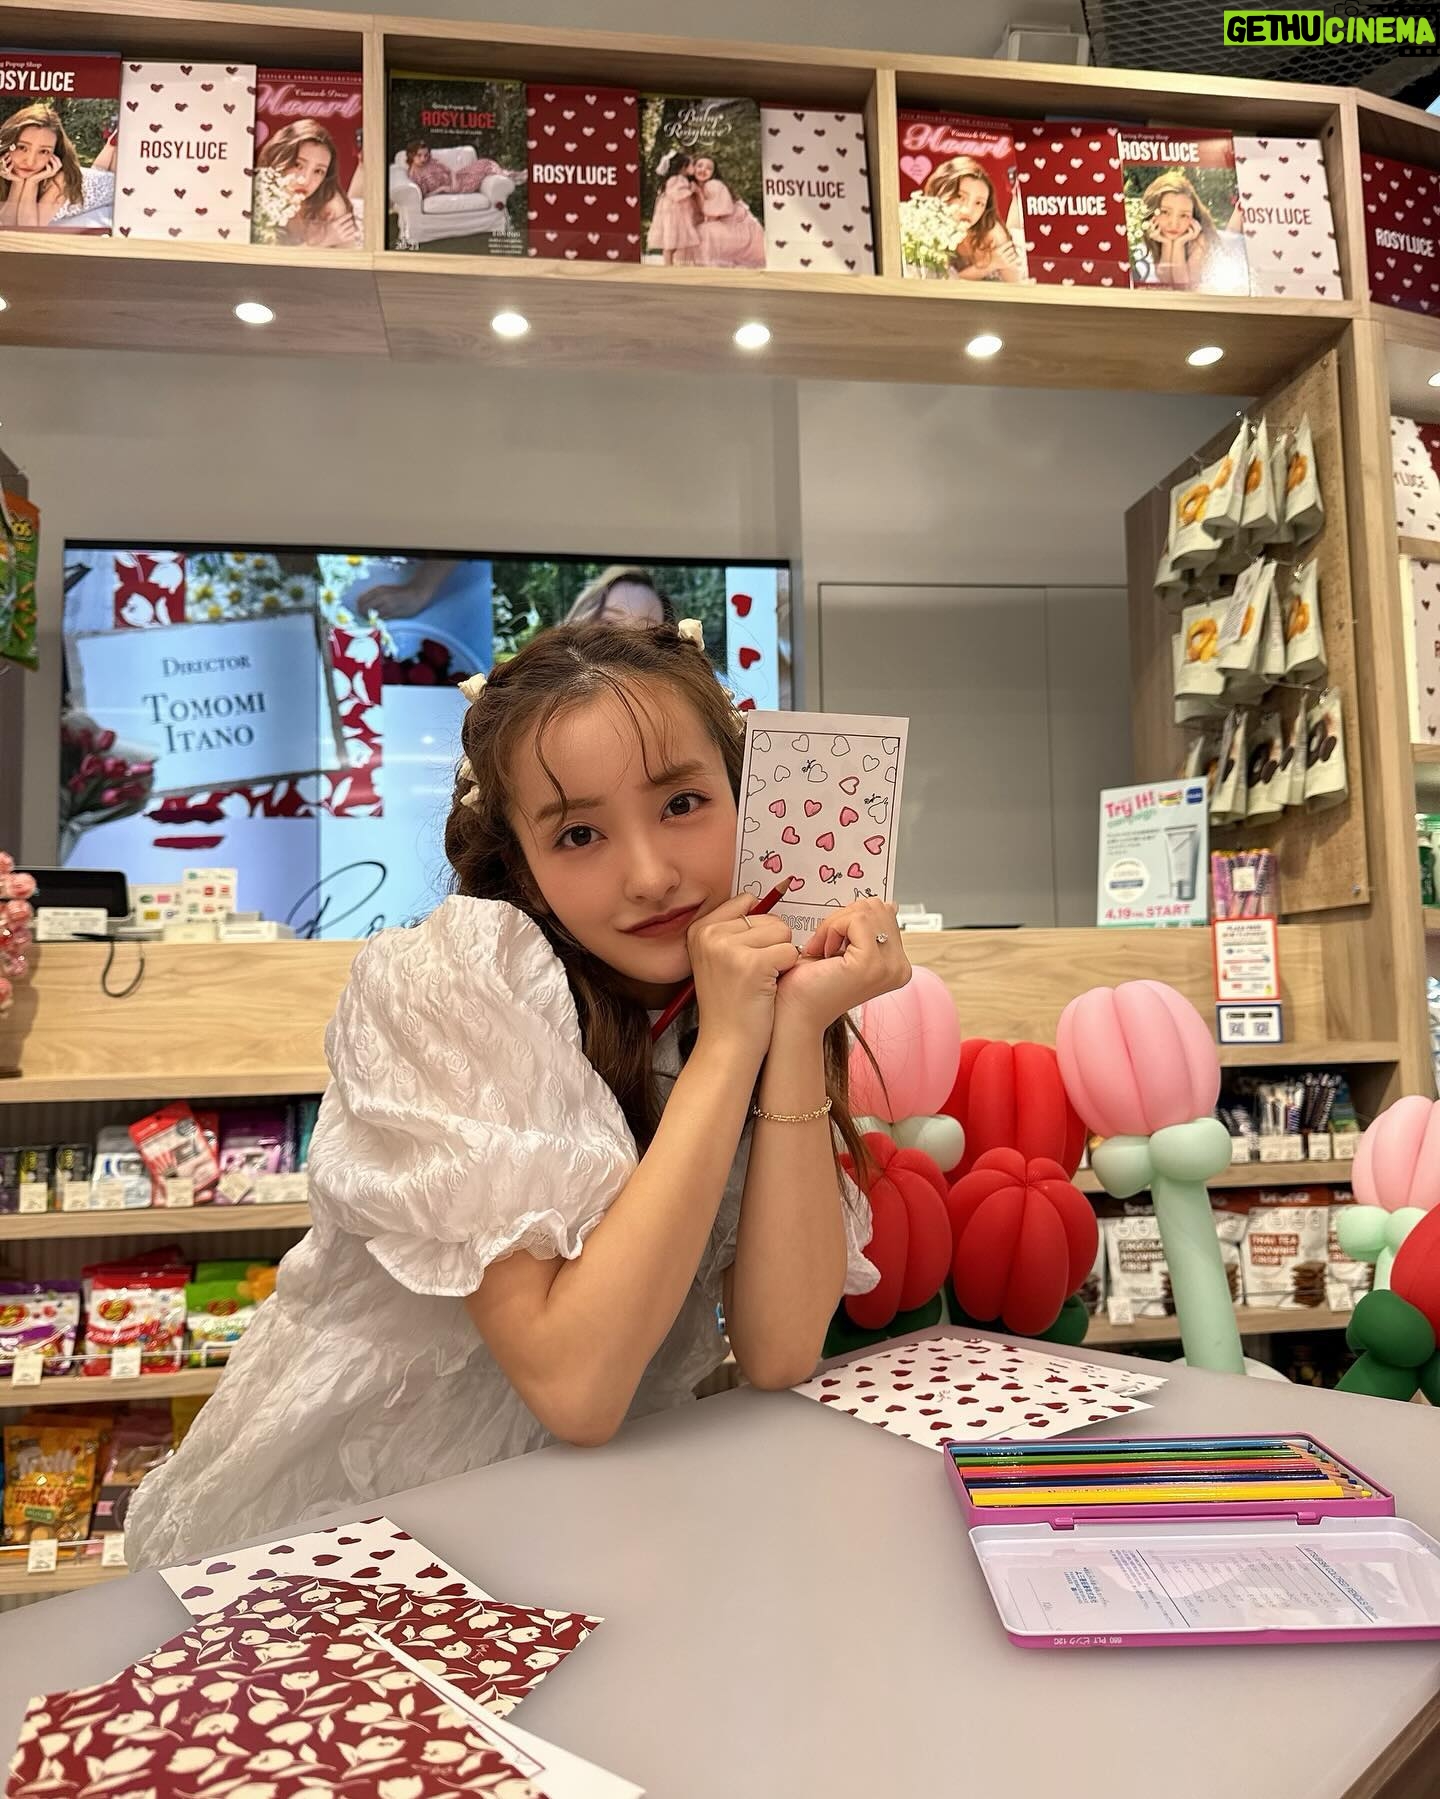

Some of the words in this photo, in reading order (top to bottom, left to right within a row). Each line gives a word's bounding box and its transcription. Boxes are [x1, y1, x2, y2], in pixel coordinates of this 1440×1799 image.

[421, 110, 496, 128] ROSYLUCE
[678, 103, 724, 129] Baby
[140, 141, 228, 160] ROSYLUCE
[1119, 141, 1200, 162] ROSYLUCE
[533, 164, 617, 185] ROSYLUCE
[766, 178, 846, 198] ROSYLUCE
[1027, 196, 1107, 215] ROSYLUCE
[1375, 227, 1435, 258] ROSYLUCE
[162, 655, 251, 677] DIRECTOR
[142, 692, 265, 724] TOMOMI
[166, 724, 254, 753] ITANO
[1105, 801, 1133, 818] Try
[1146, 903, 1191, 918] START
